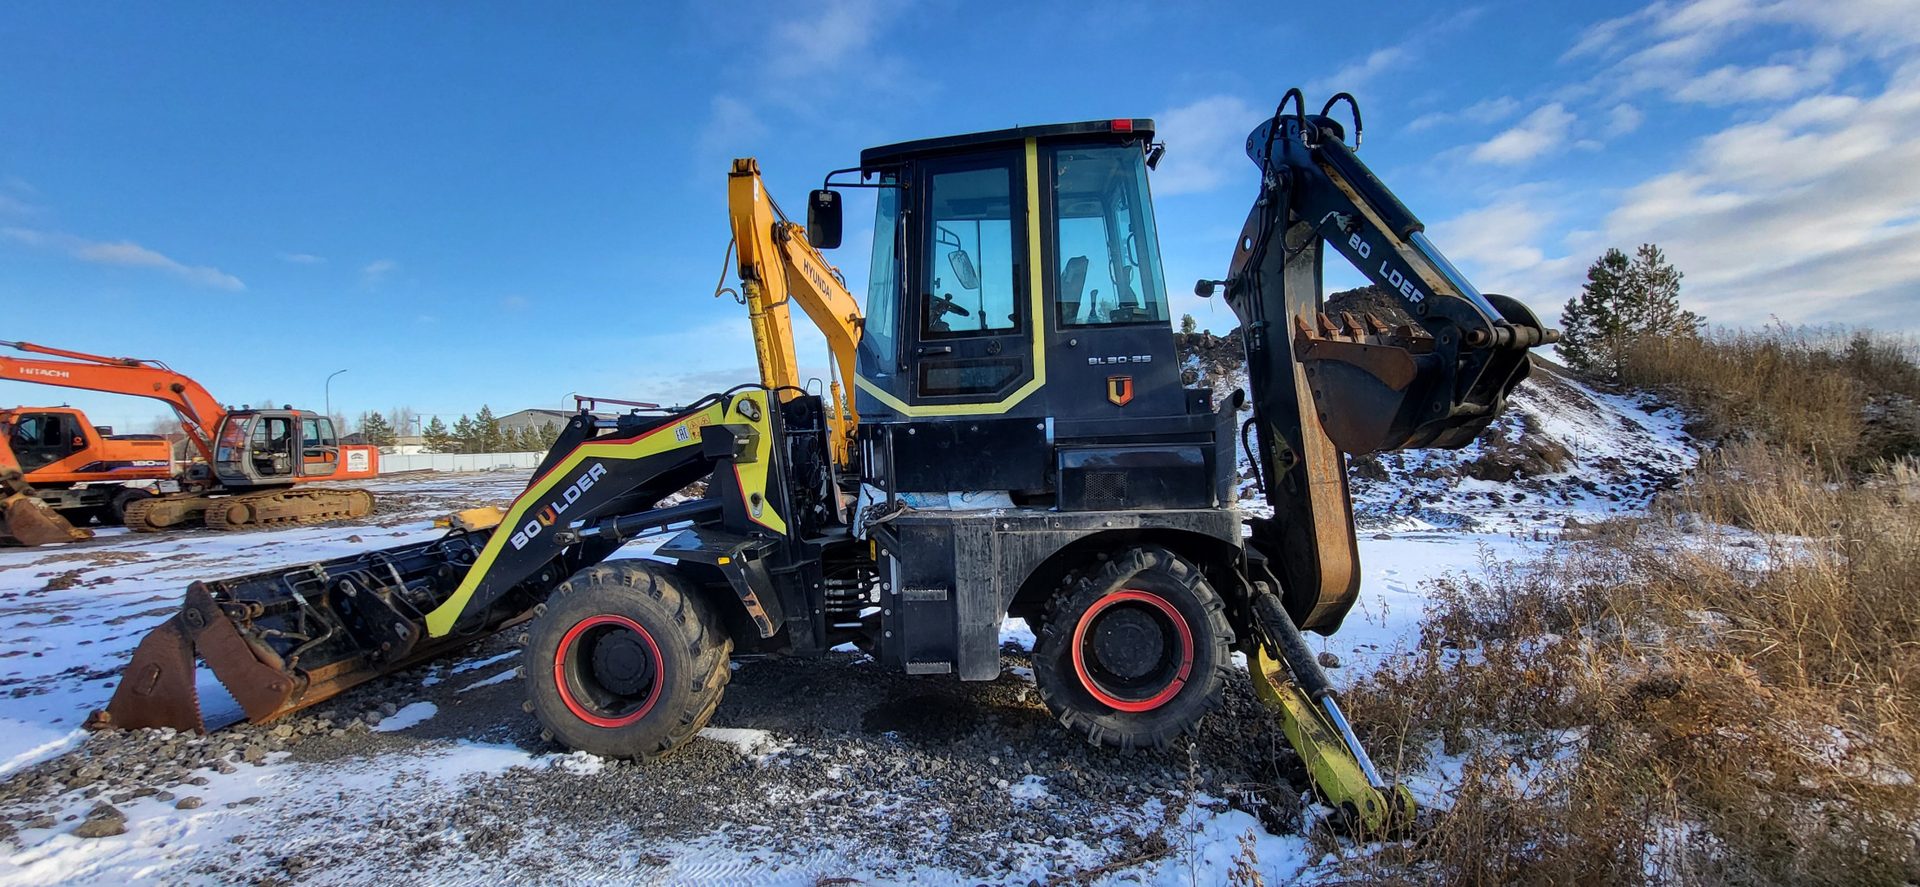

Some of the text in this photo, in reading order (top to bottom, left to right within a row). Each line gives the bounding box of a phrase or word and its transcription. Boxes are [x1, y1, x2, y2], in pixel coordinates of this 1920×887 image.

[803, 258, 832, 301] HYUNDAI
[20, 367, 69, 378] HITACHI
[510, 462, 607, 551] BOULDER
